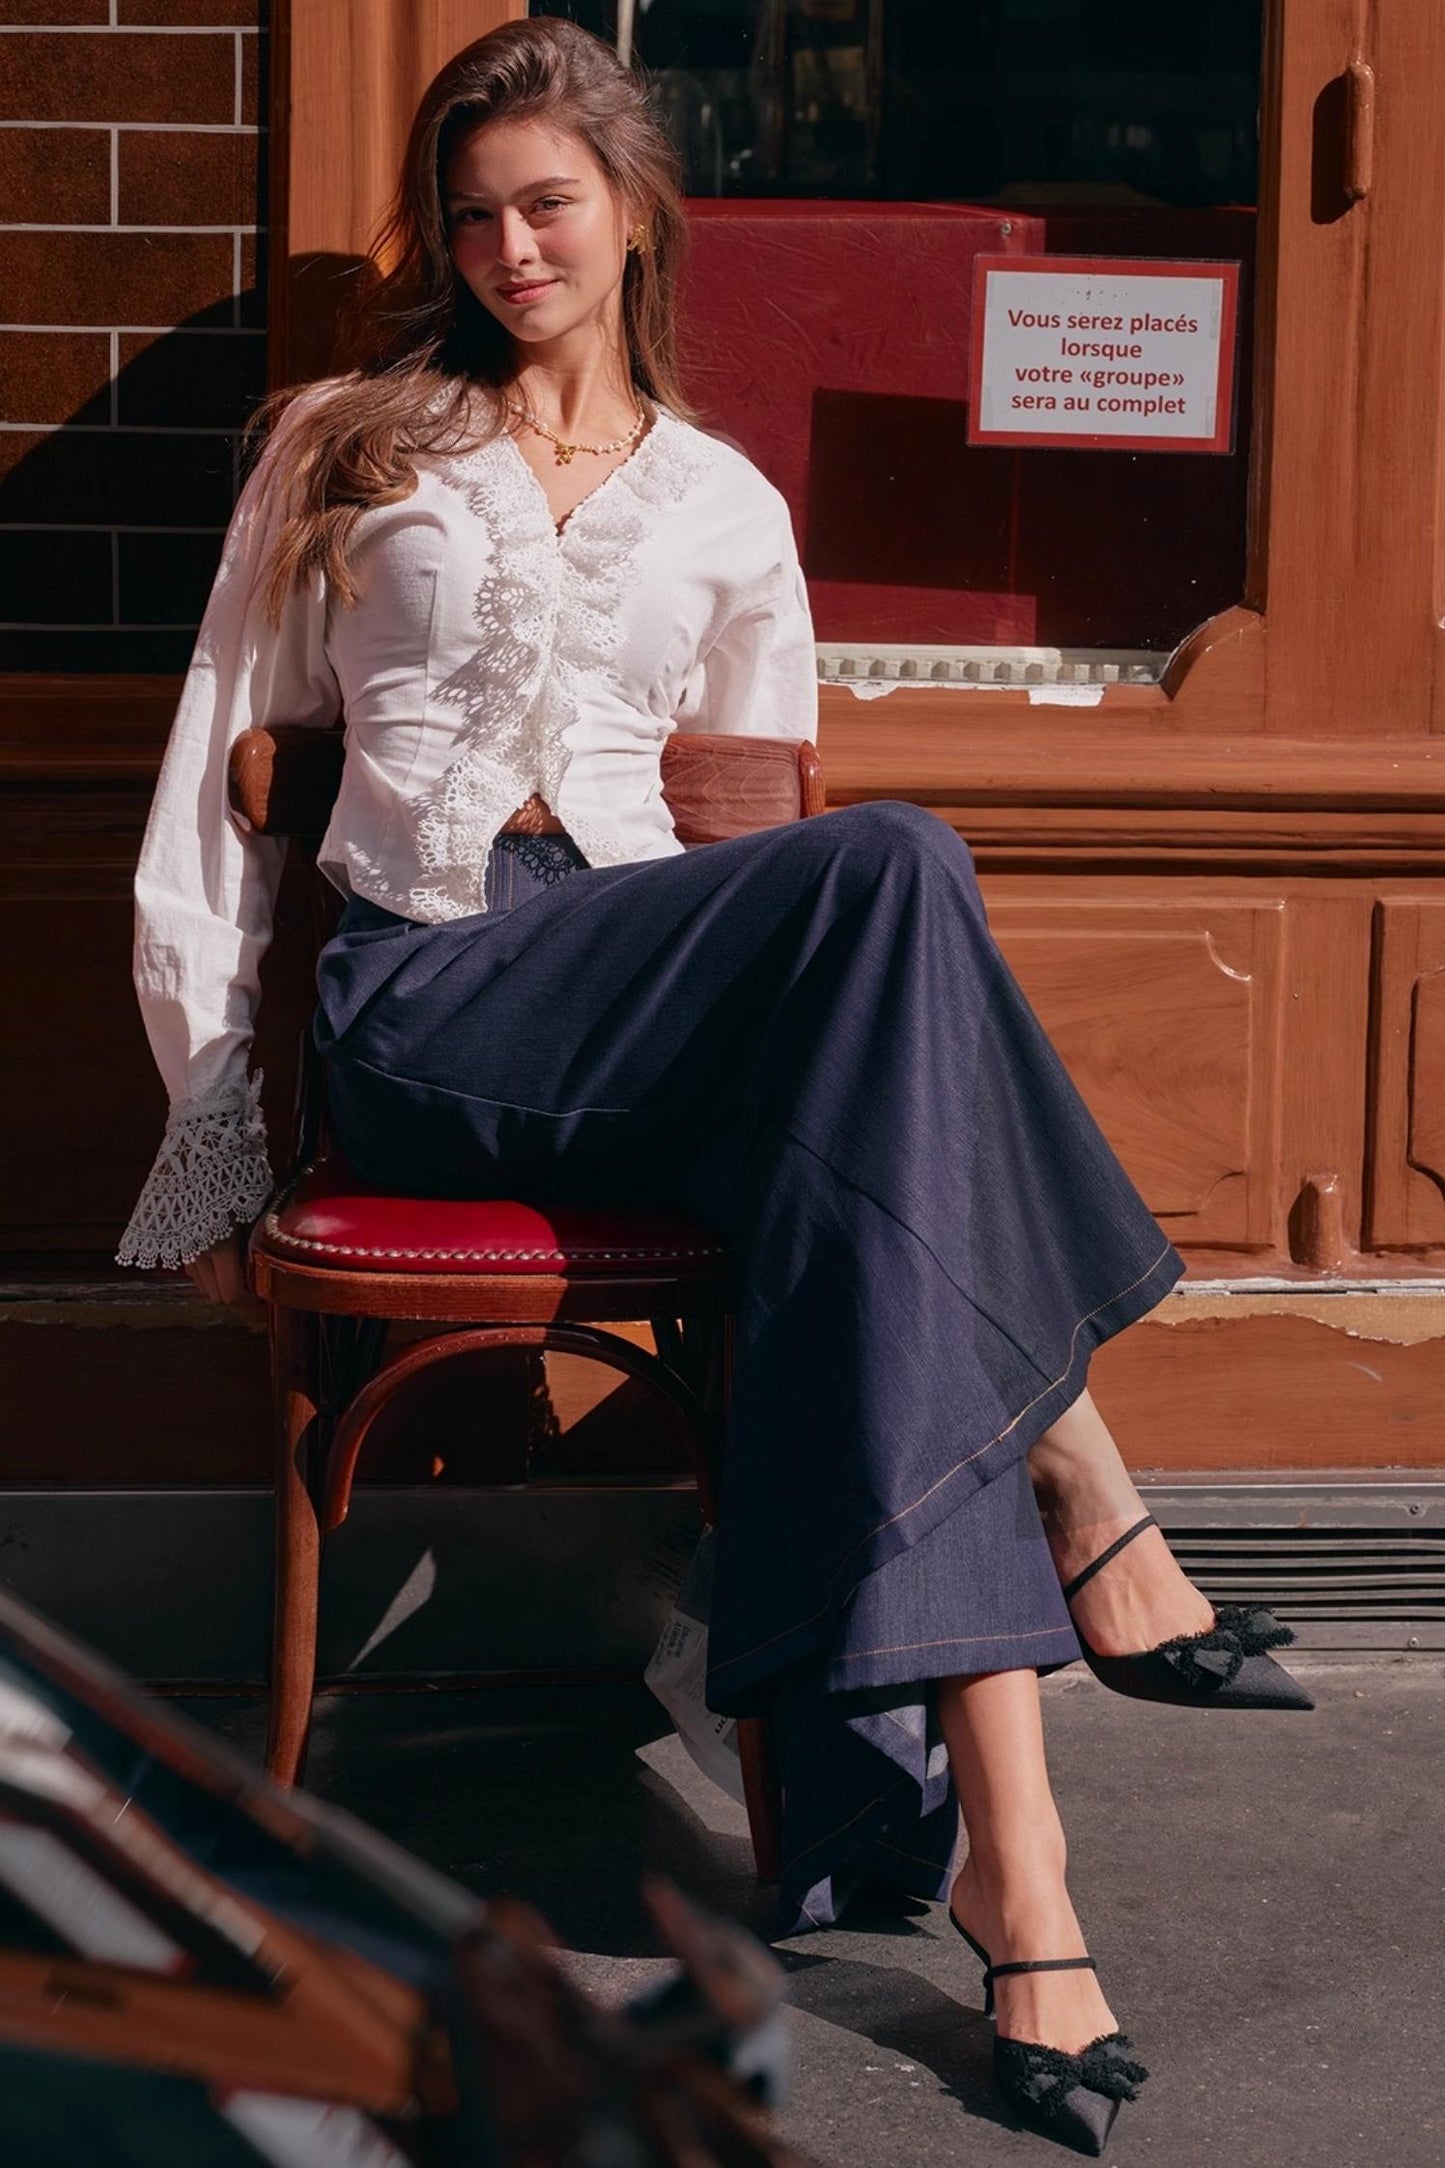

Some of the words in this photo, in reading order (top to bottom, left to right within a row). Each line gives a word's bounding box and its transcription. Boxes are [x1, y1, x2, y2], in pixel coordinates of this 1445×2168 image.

[1008, 310, 1060, 328] Vous
[1068, 314, 1122, 330] serez
[1130, 314, 1197, 334] placés
[1061, 338, 1141, 361] lorsque
[1015, 366, 1072, 383] votre
[1080, 371, 1184, 389] «groupe»
[1012, 395, 1056, 410] sera
[1064, 397, 1089, 411] au
[1097, 395, 1185, 416] complet
